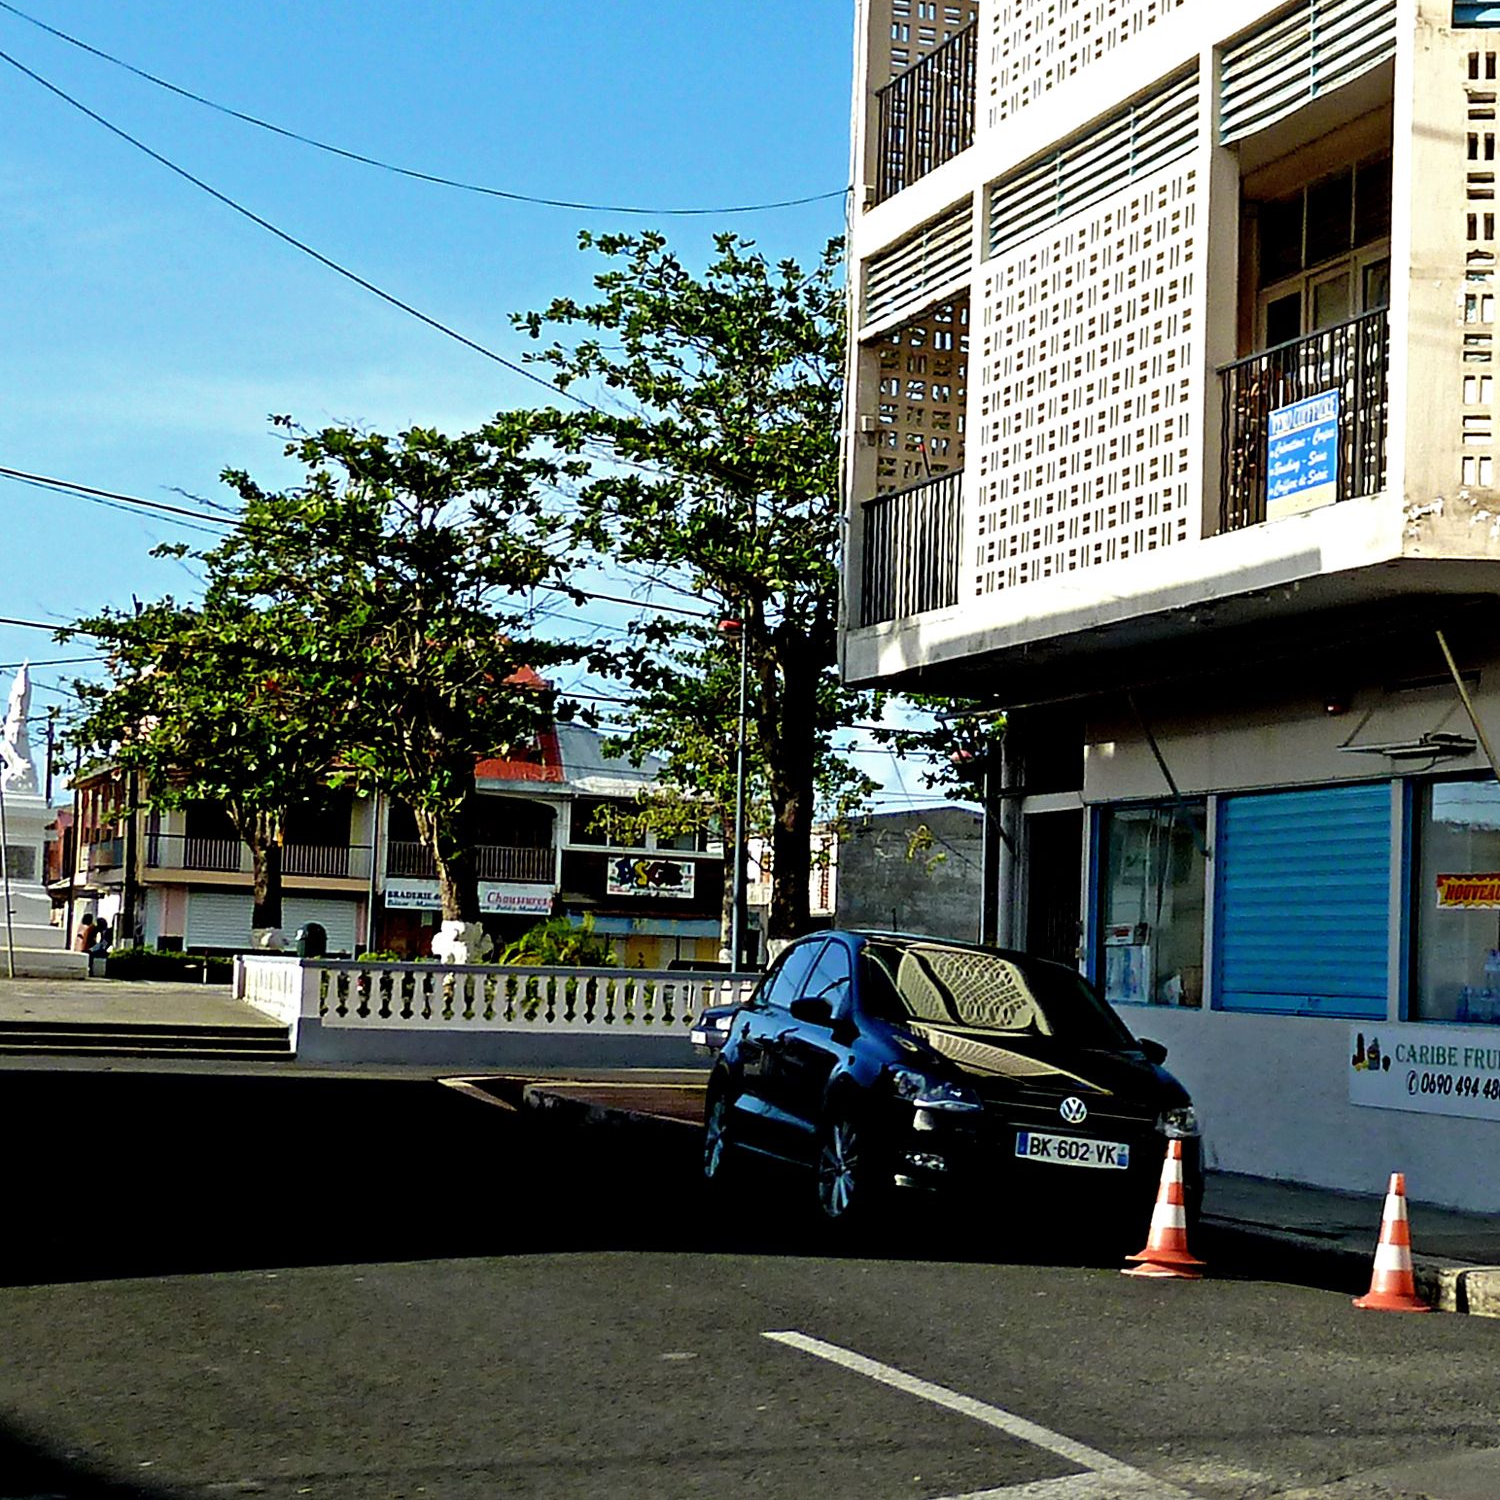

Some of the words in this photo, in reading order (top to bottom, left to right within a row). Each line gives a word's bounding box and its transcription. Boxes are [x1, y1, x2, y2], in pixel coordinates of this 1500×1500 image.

[1395, 1043, 1458, 1067] CARIBE
[1420, 1072, 1453, 1096] 0690
[1455, 1075, 1481, 1098] 494
